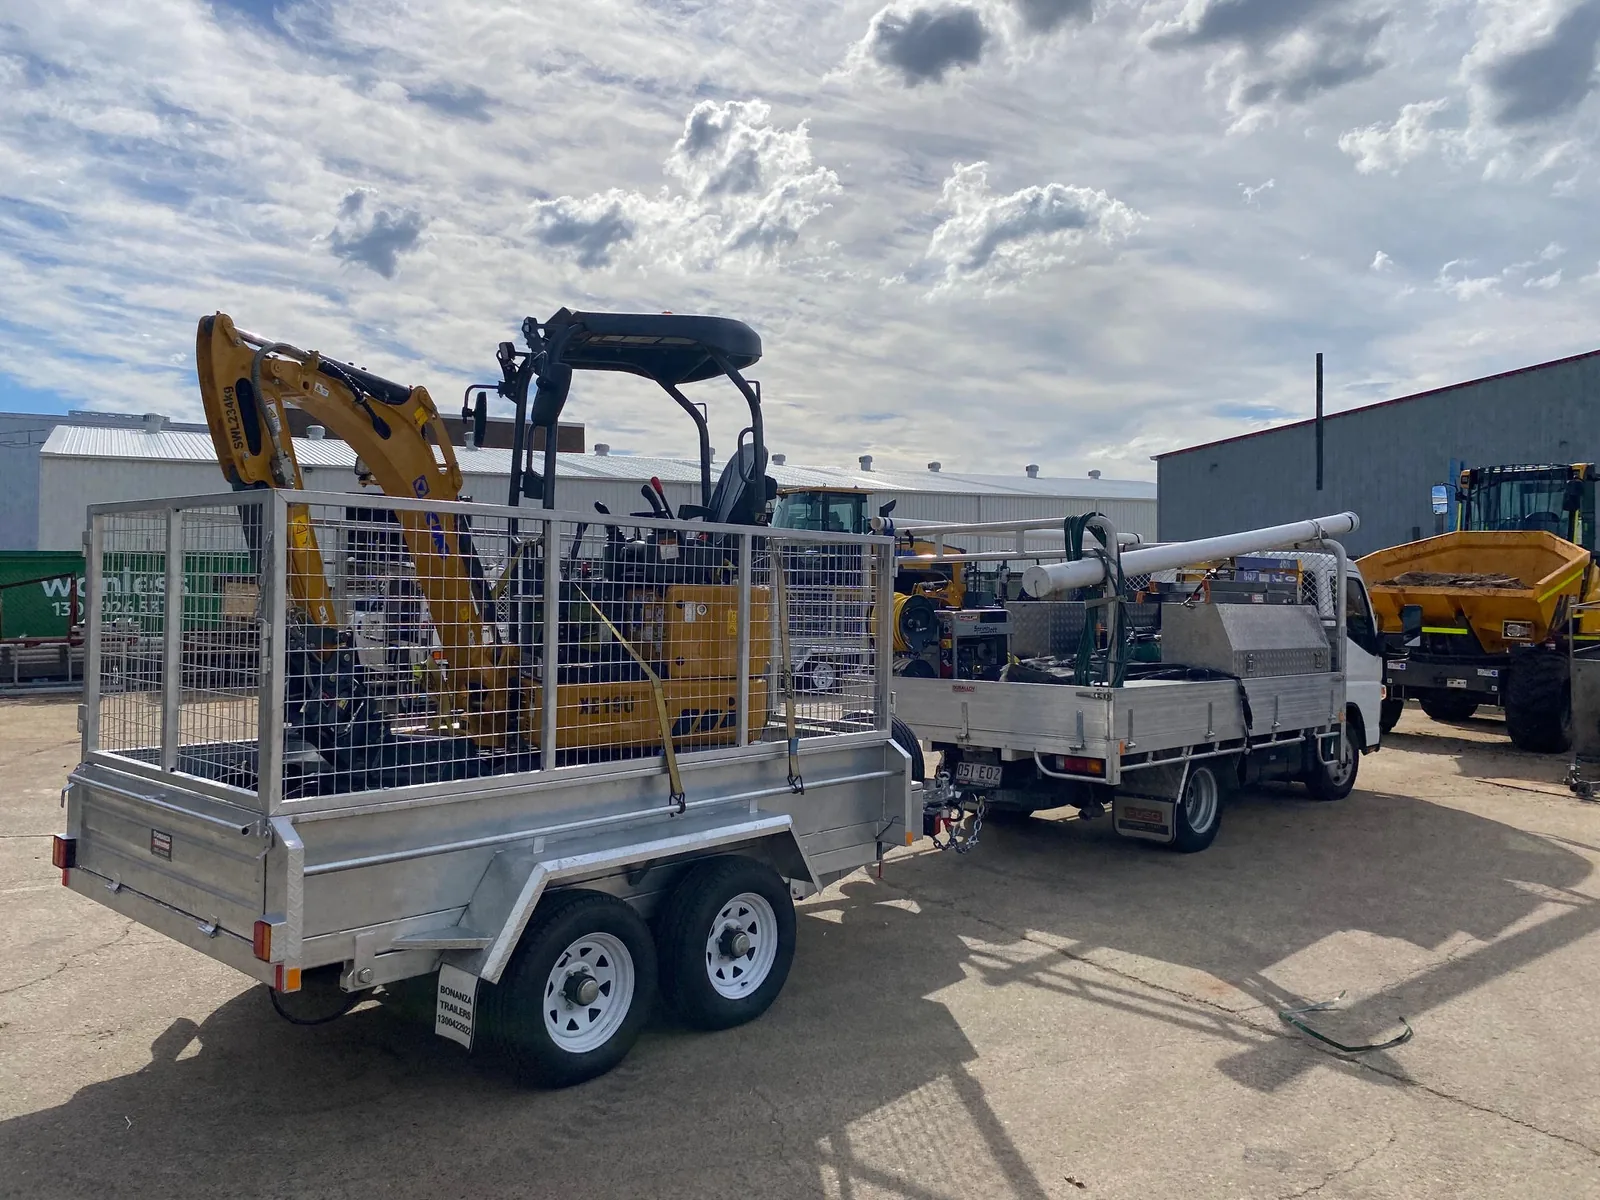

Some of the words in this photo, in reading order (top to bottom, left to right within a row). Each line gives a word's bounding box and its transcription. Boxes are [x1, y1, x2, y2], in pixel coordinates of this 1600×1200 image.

[957, 763, 974, 778] 051
[440, 985, 472, 1005] BONANZA
[440, 1000, 471, 1021] TRAILERS
